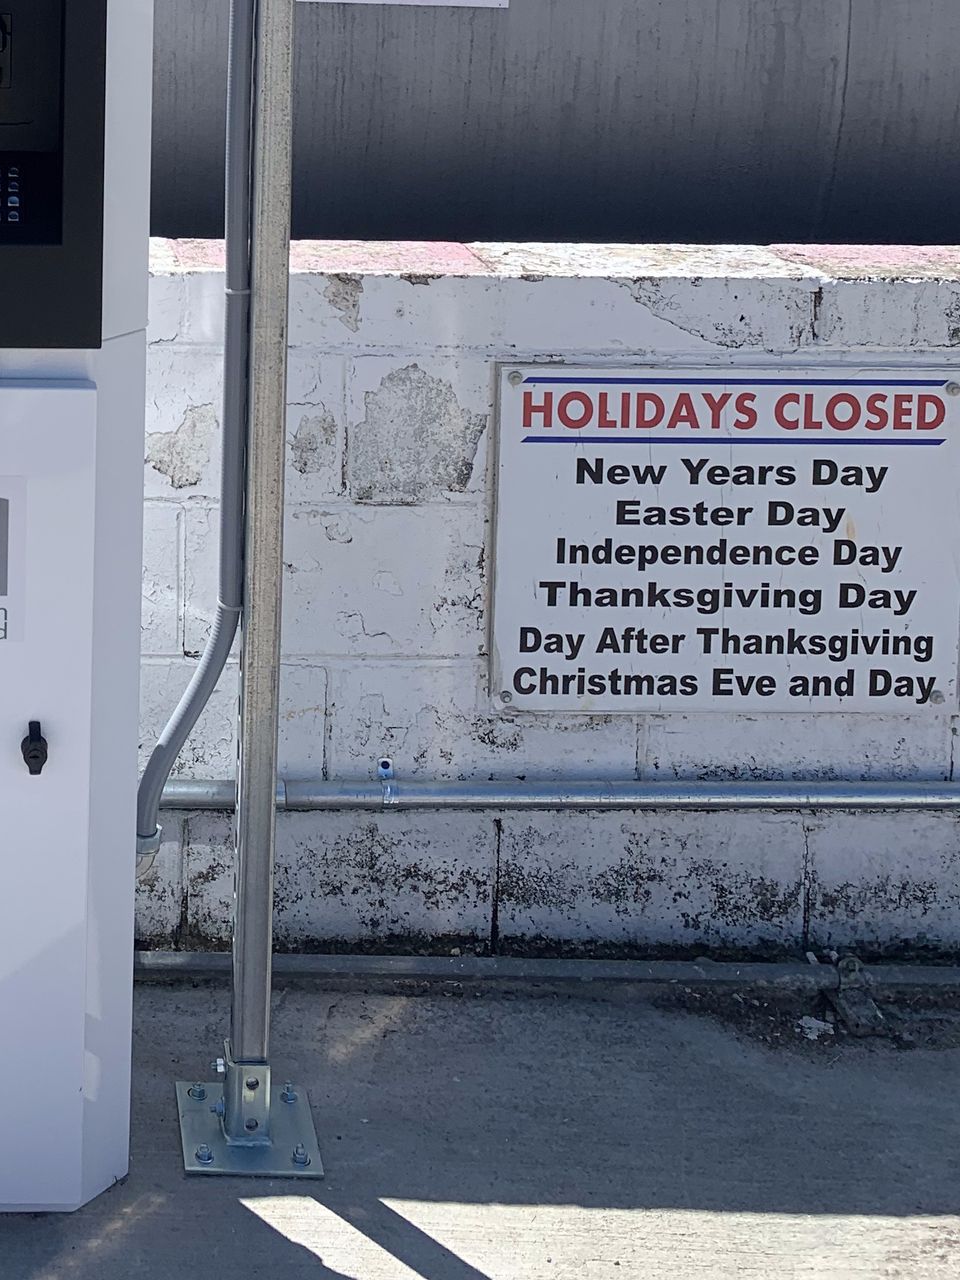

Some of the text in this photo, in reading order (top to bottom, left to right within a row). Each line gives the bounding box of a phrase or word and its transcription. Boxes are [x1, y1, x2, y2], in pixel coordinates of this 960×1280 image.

[521, 390, 946, 431] HOLIDAYS CLOSED
[575, 458, 888, 493] New Years Day
[616, 500, 846, 532] Easter Day
[556, 538, 902, 573] Independence Day
[539, 581, 917, 615] Thanksgiving Day
[519, 627, 934, 662] Day After Thanksgiving
[513, 666, 936, 704] Christmas Eve and Day
